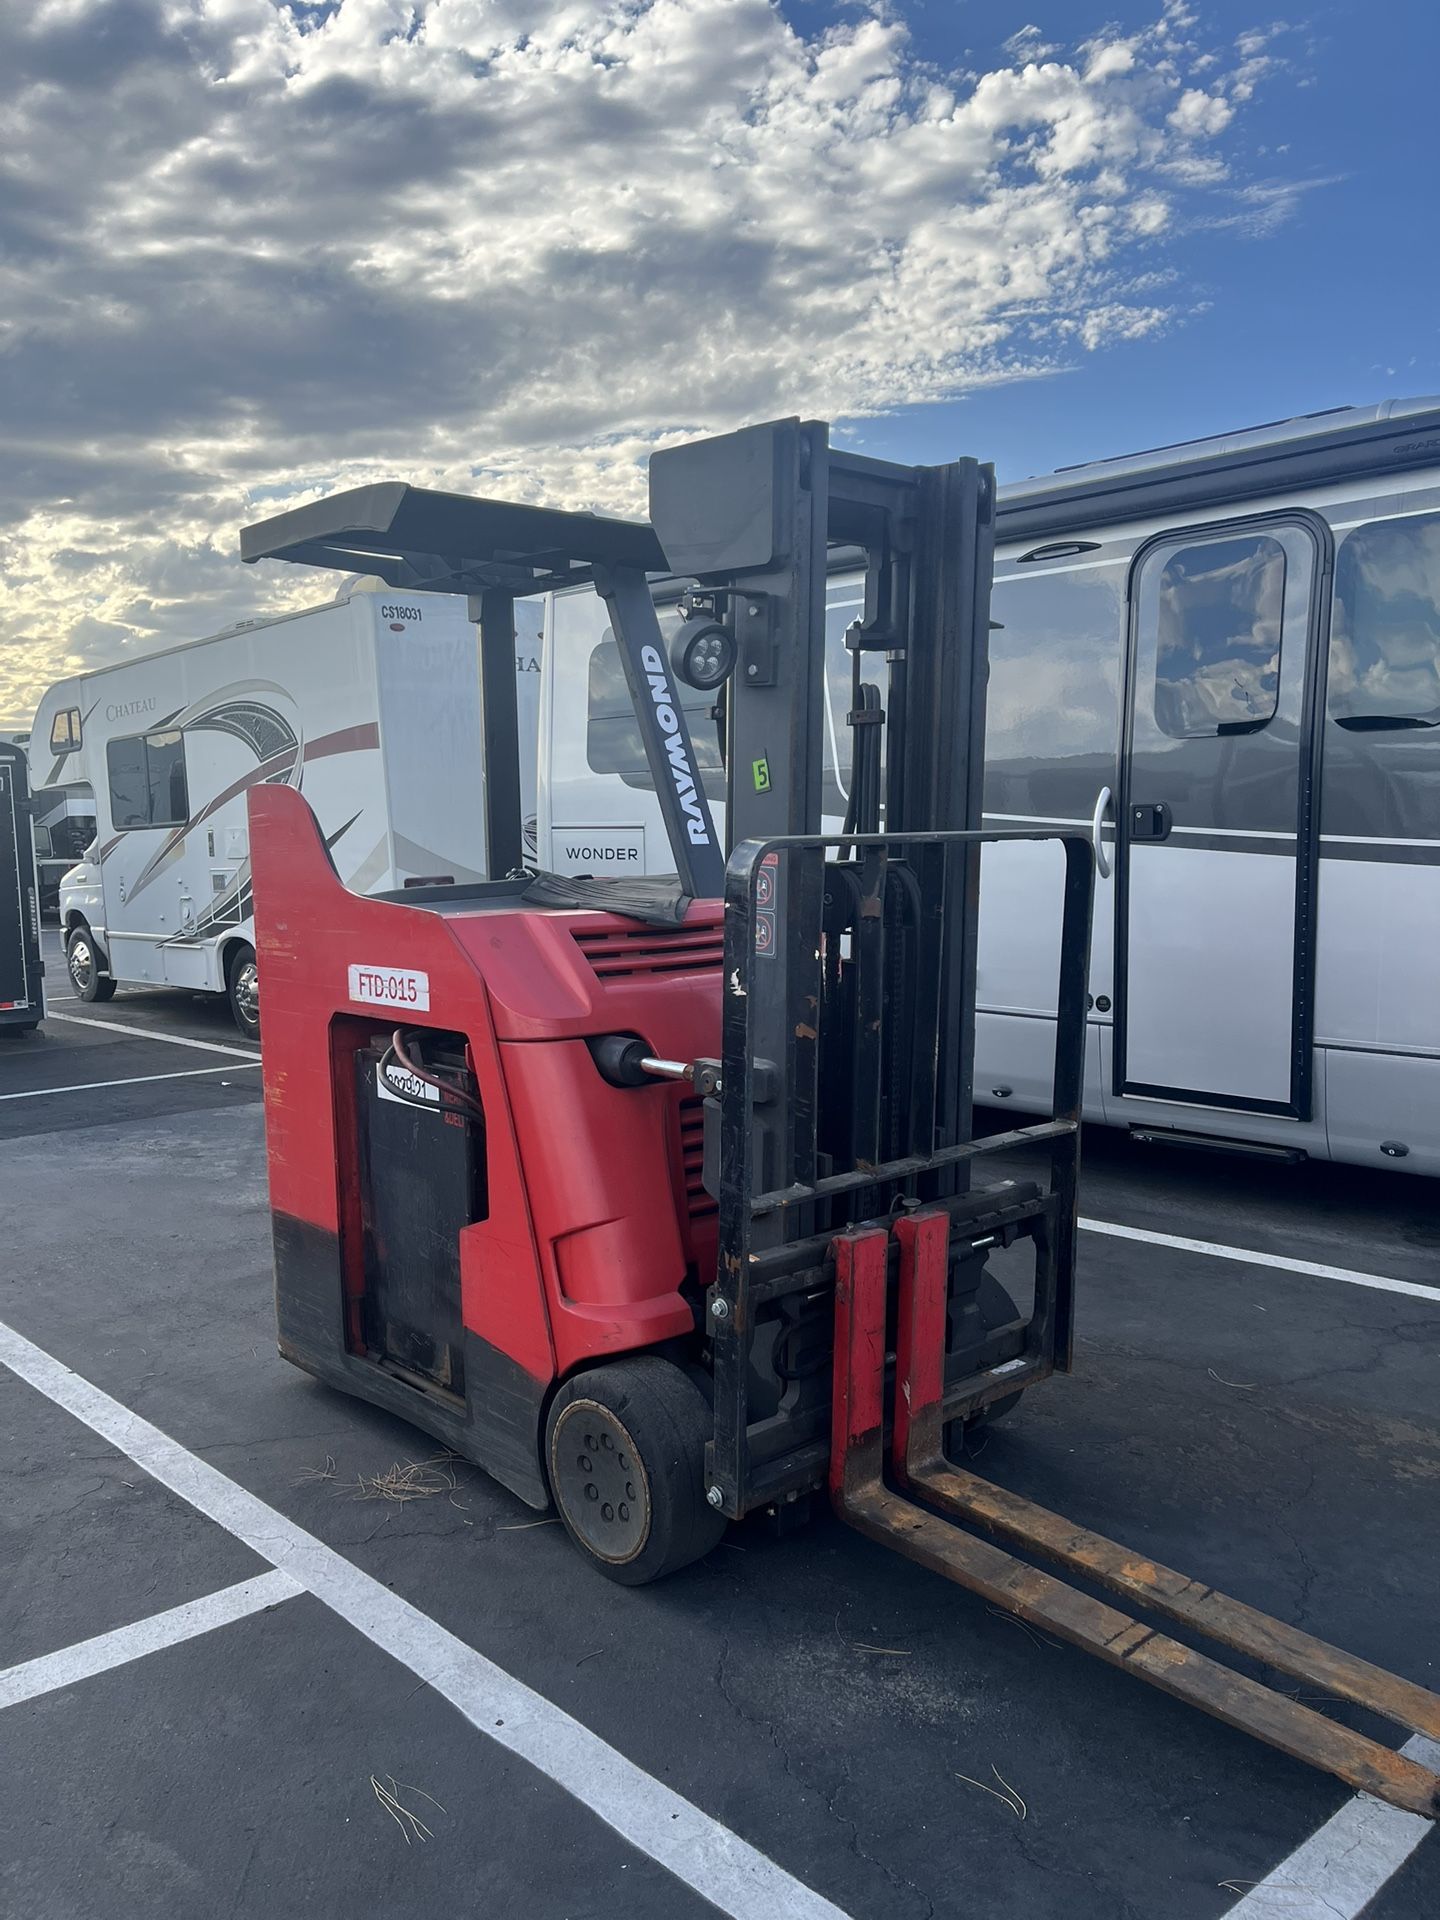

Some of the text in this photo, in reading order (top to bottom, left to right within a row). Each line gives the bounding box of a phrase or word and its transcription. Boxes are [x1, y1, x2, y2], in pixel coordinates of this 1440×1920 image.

[381, 604, 423, 622] CS18031
[105, 696, 156, 722] CHATEAU
[641, 645, 710, 845] RAYMOND
[757, 763, 768, 786] 5
[565, 847, 639, 861] WONDER
